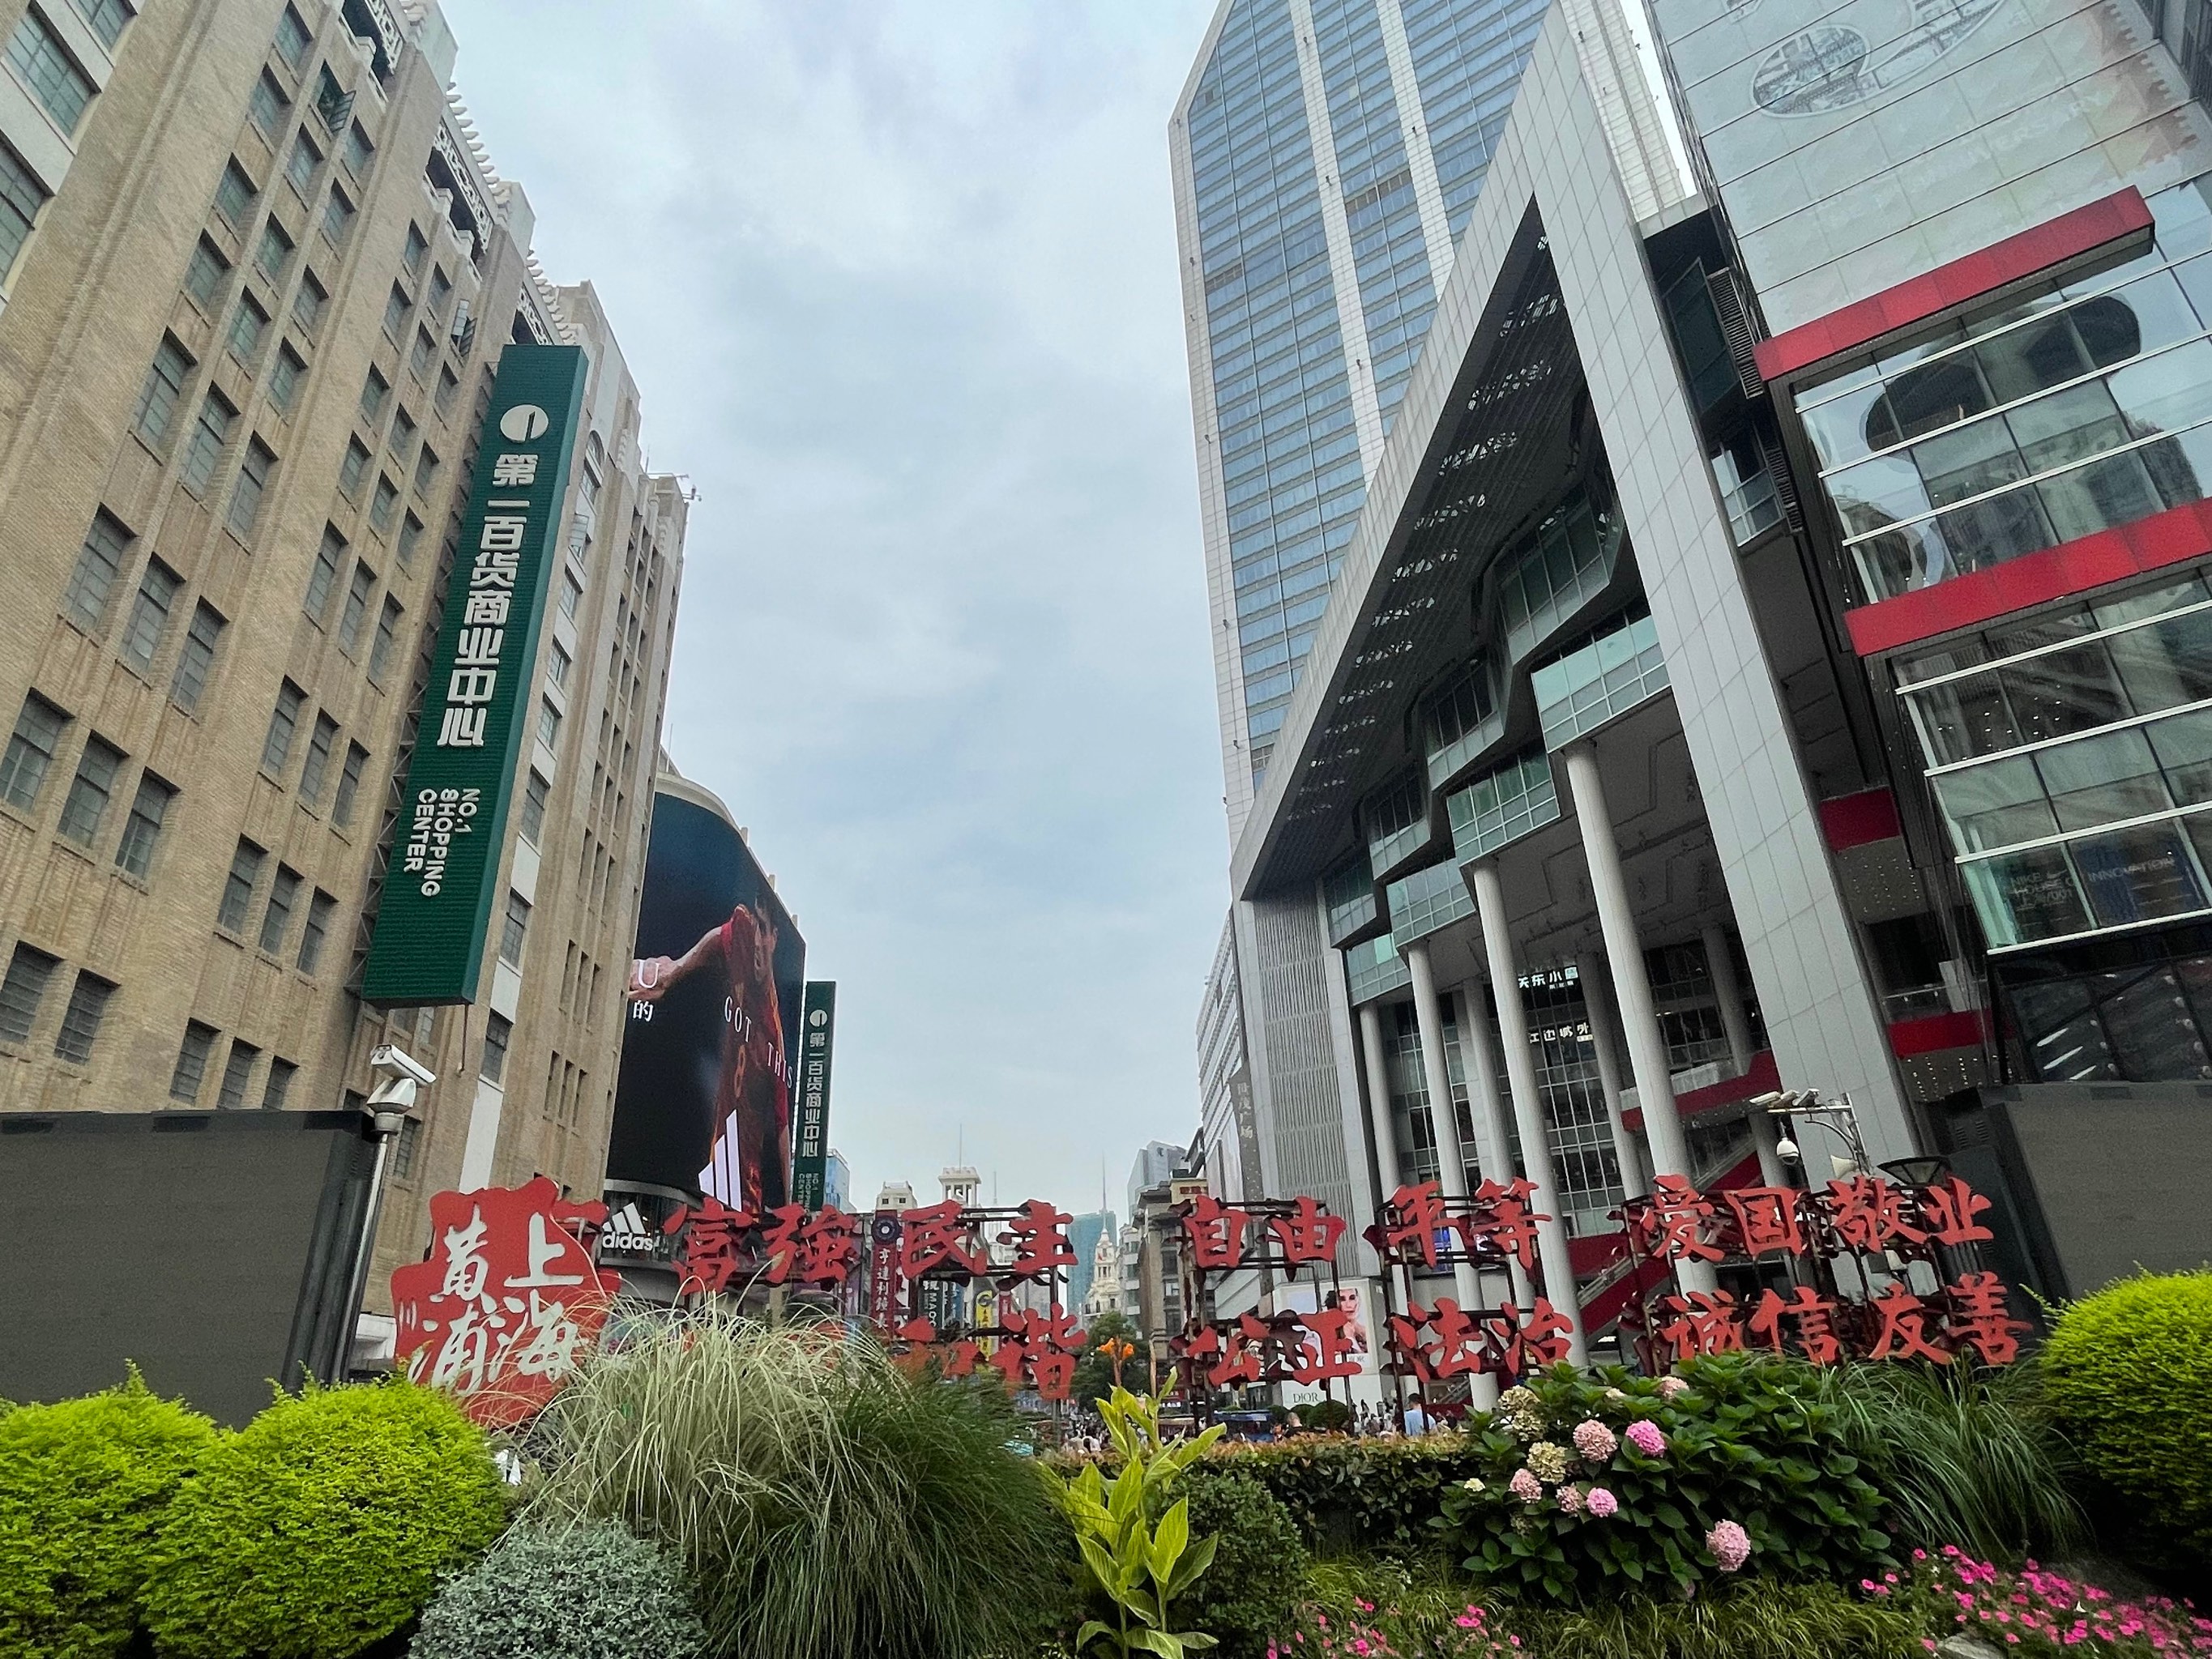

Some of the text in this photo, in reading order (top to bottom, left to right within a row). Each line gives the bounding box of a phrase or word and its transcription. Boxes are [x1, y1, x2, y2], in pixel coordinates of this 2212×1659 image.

[437, 454, 539, 748] 第一百货商业中心
[404, 788, 438, 872] CENTER
[421, 788, 459, 898] SHOPPING
[455, 788, 481, 833] NO.1
[724, 996, 752, 1043] GOT
[767, 1042, 793, 1089] THIS
[803, 1032, 826, 1158] 第一百货商业中心
[602, 1232, 653, 1251] didas
[663, 1197, 858, 1295] 富强
[899, 1199, 1078, 1279] 民主
[1184, 1194, 1347, 1269] 自由
[1386, 1176, 1552, 1271] 平等
[408, 1201, 506, 1397] 黄浦
[489, 1212, 588, 1382] 上海
[1390, 1296, 1574, 1383] 法治
[1185, 1307, 1363, 1387] 公正
[1292, 1392, 1321, 1403] DIOR
